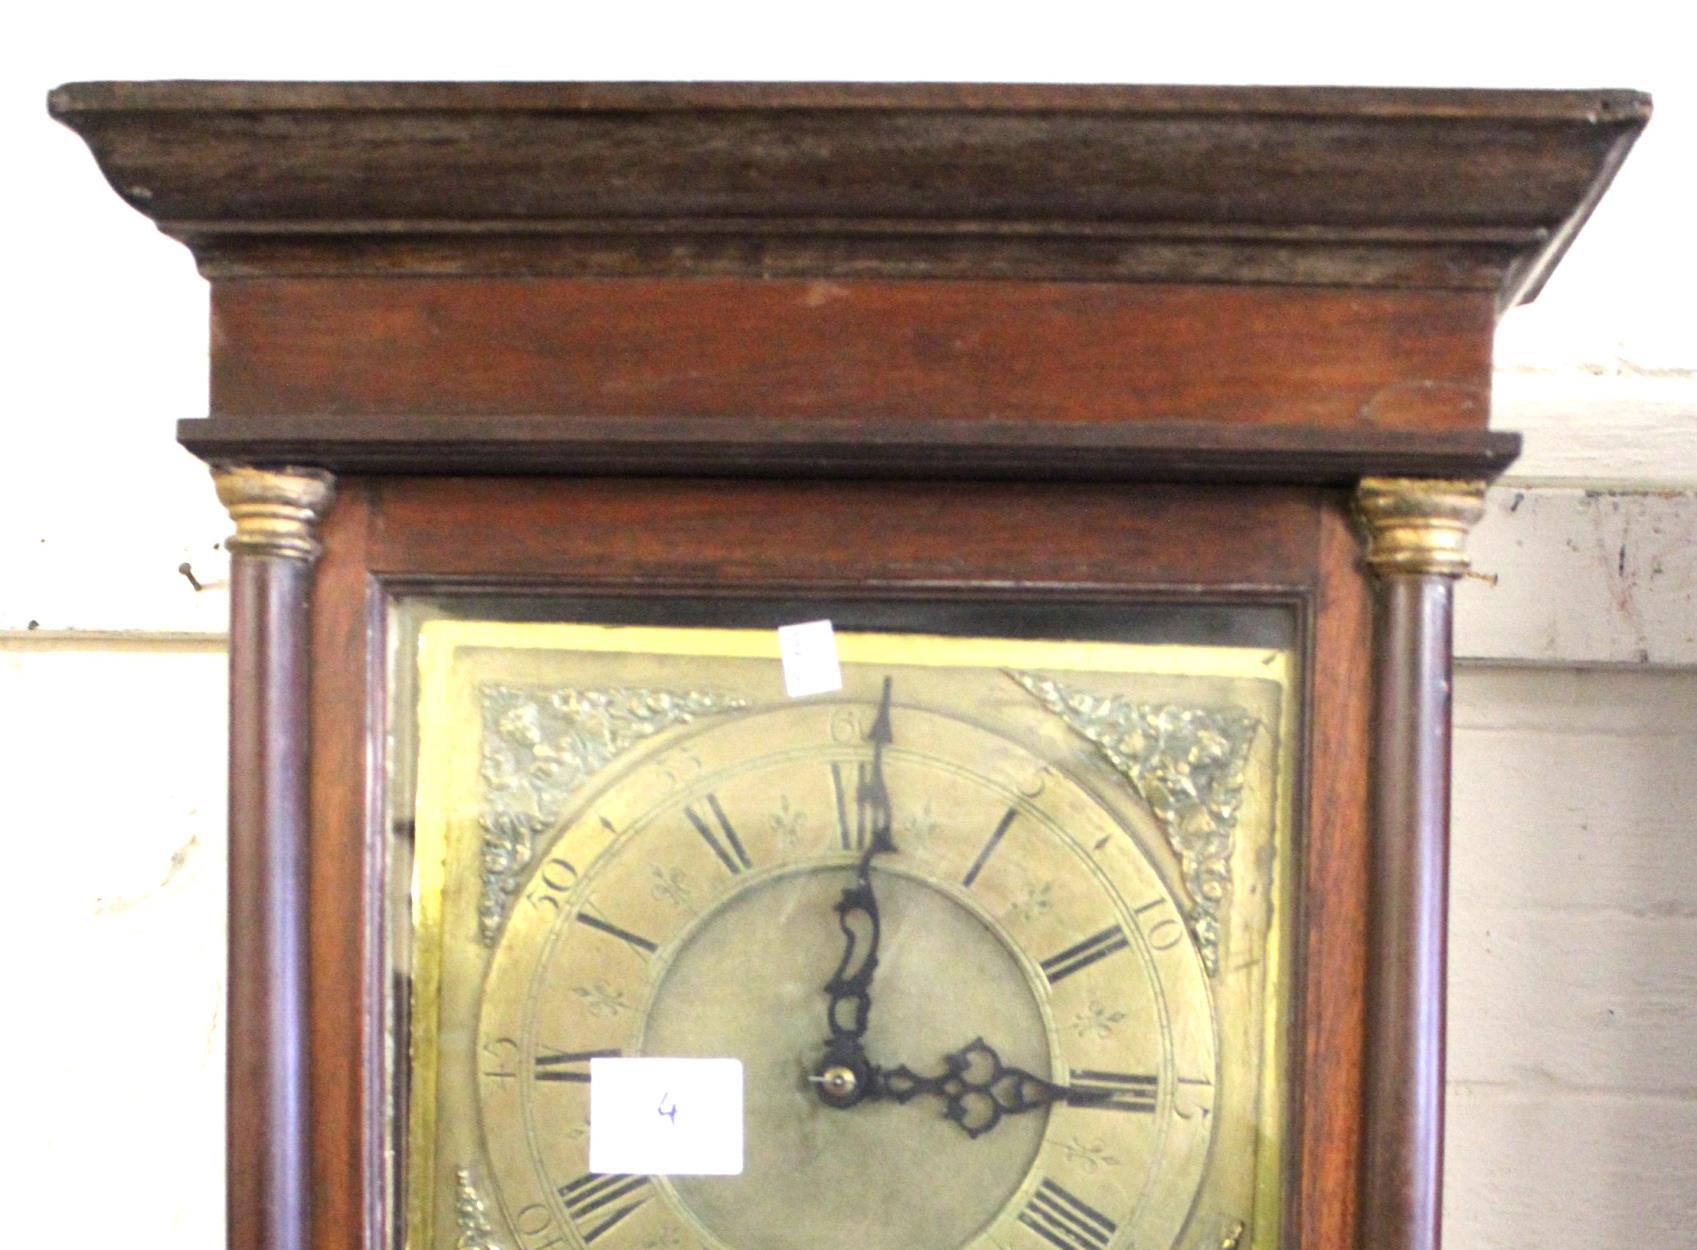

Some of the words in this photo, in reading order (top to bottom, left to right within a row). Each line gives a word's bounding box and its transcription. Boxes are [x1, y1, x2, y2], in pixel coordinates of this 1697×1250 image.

[526, 857, 577, 909] 50
[1134, 897, 1183, 951] 10
[658, 1092, 678, 1126] 4
